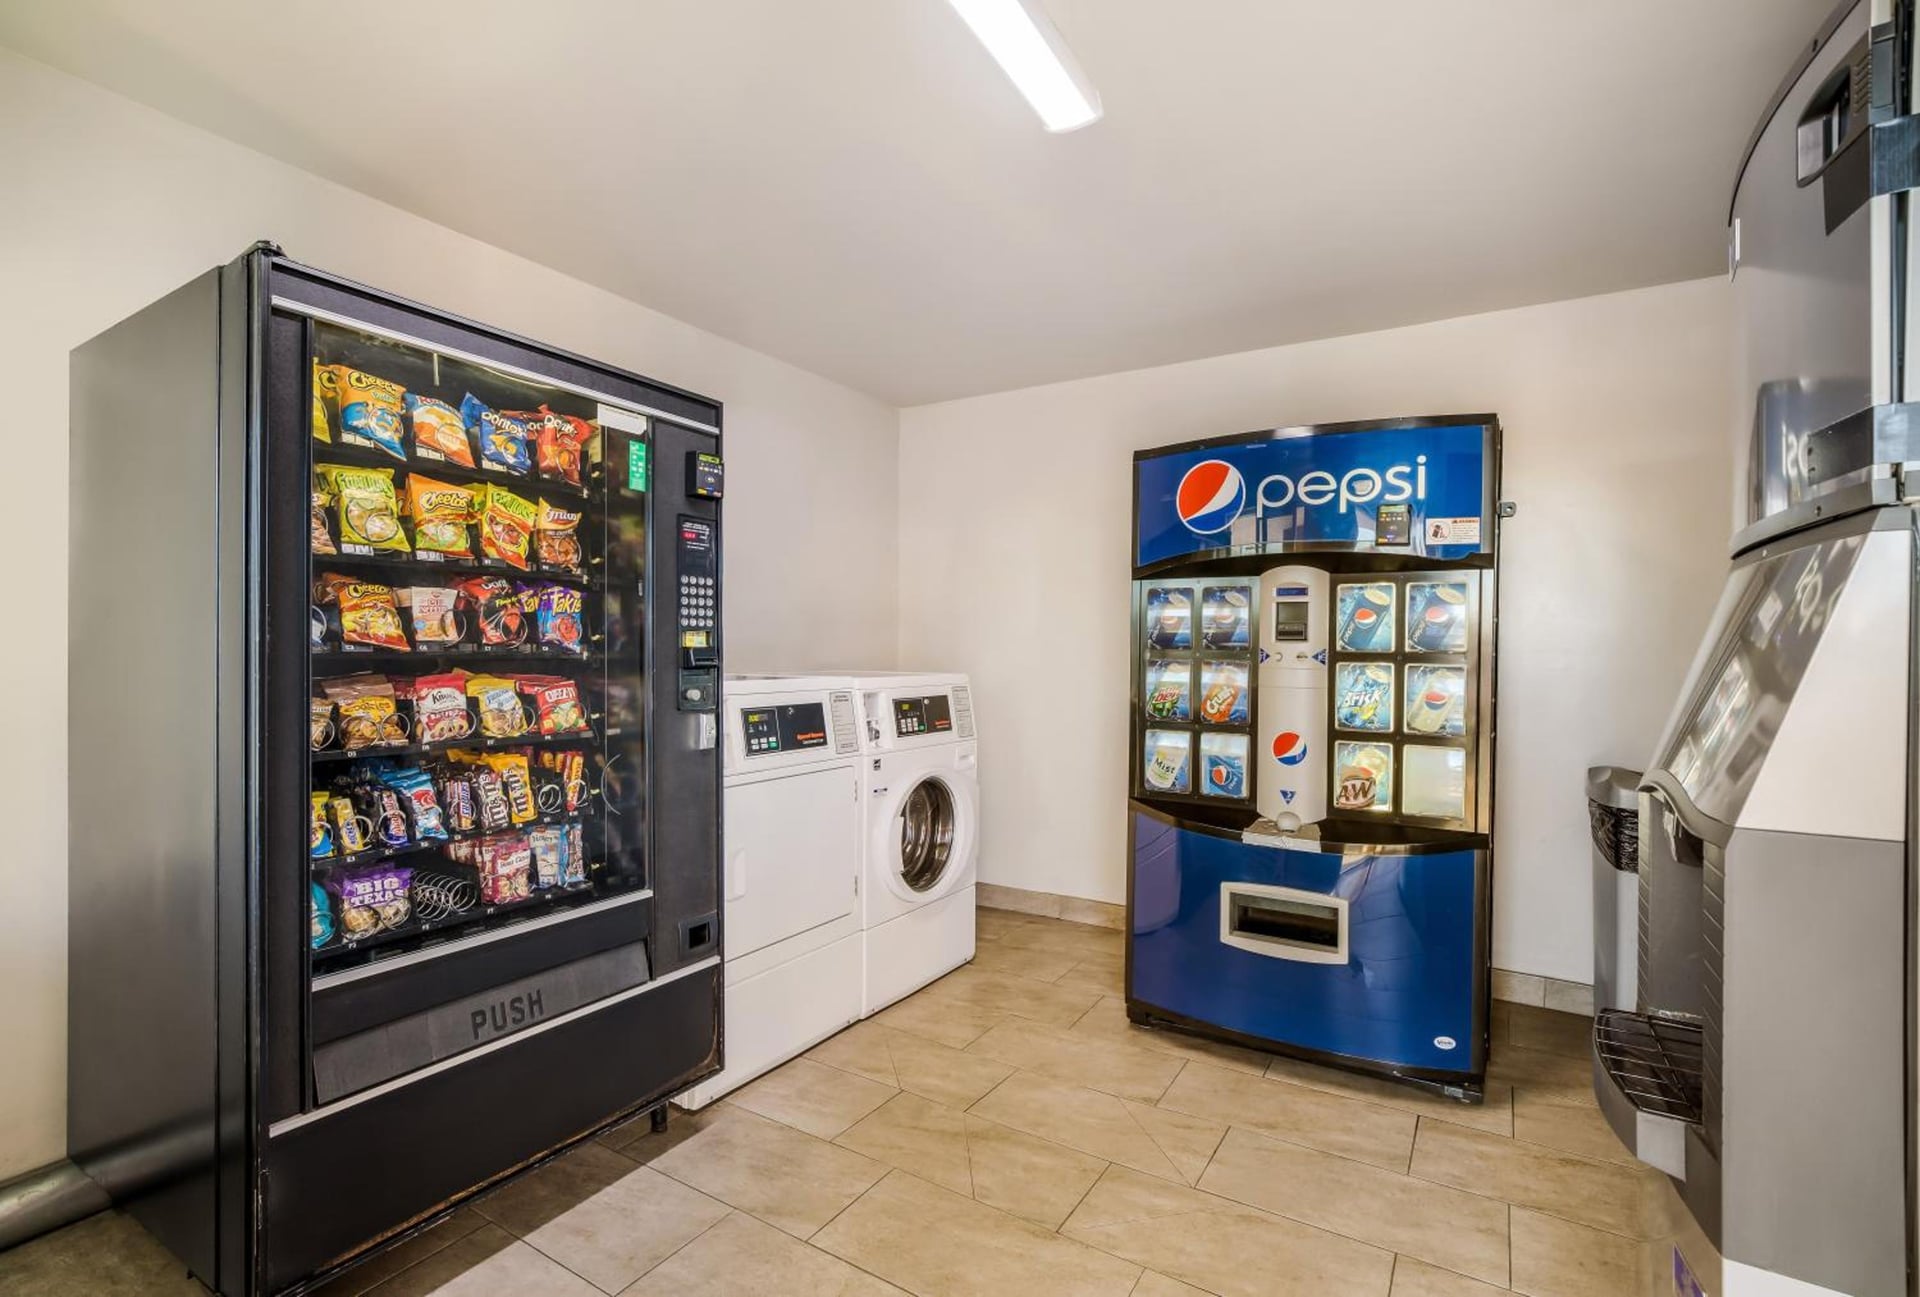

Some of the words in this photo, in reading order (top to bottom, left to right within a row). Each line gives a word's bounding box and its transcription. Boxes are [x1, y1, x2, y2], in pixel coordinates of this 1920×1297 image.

[1256, 455, 1427, 519] pepsi
[419, 489, 468, 512] Cheetos
[350, 888, 405, 908] TEXAS
[353, 877, 399, 896] BIG
[470, 988, 545, 1041] PUSH
